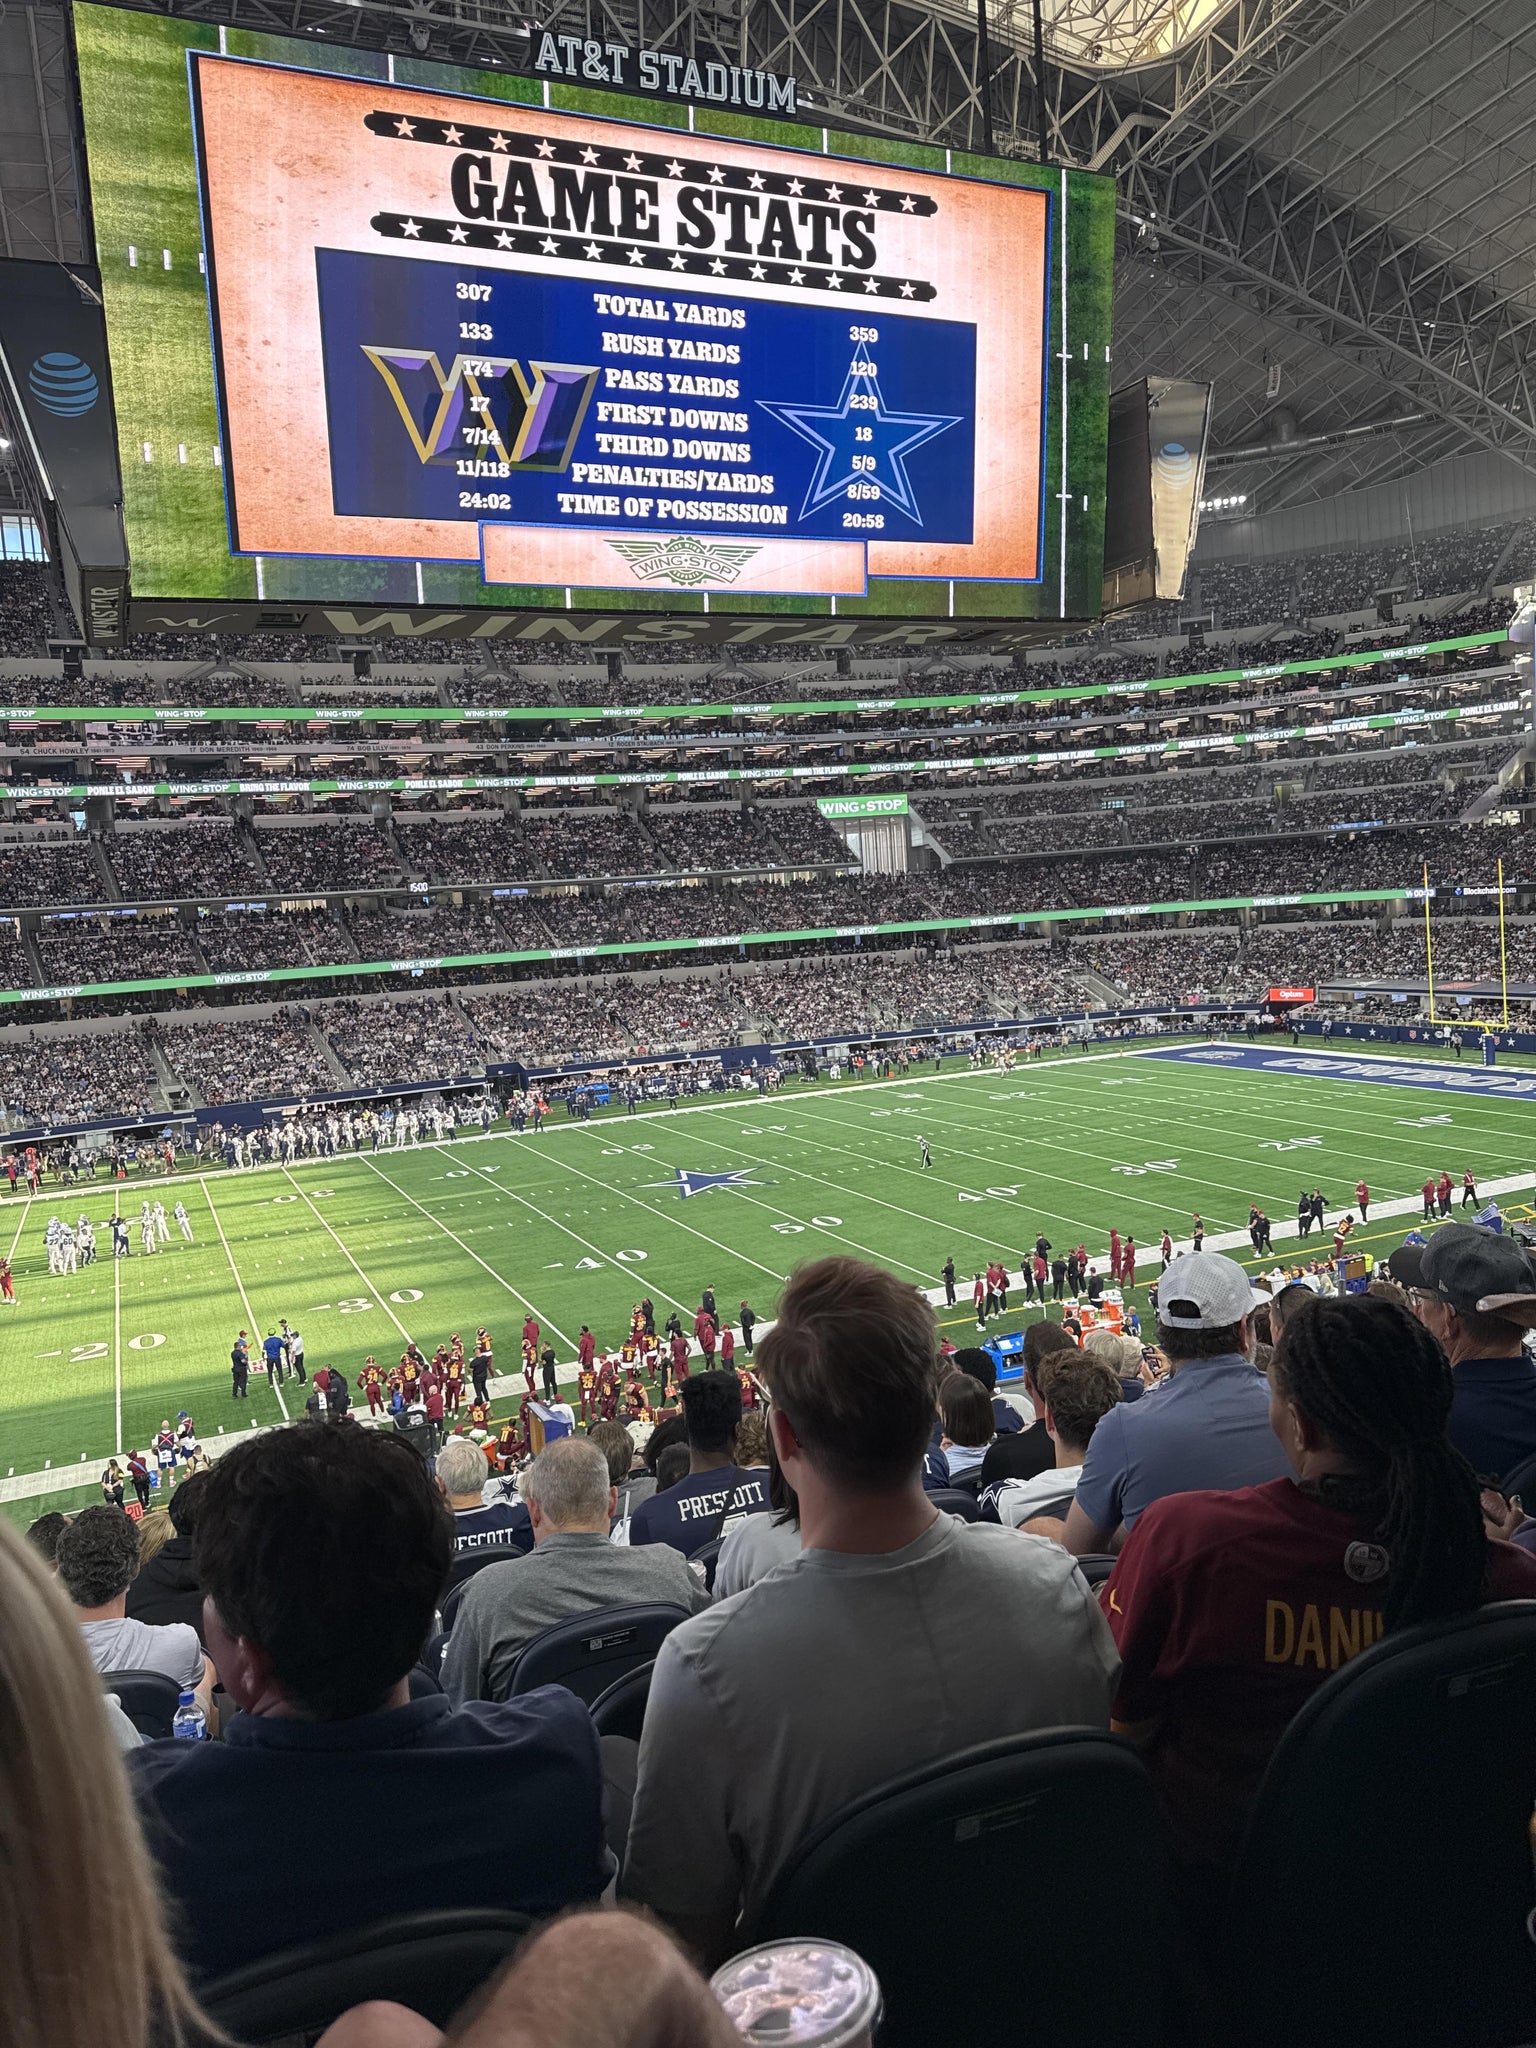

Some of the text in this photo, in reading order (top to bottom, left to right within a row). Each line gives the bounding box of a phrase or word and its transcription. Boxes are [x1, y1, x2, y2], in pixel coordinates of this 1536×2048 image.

[535, 32, 797, 114] AT&T STADIUM
[451, 153, 877, 270] GAME STATS
[456, 283, 493, 301] 307
[594, 294, 746, 329] TOTAL YARDS
[459, 323, 493, 340] 133
[849, 326, 878, 343] 359
[602, 332, 740, 364] RUSH YARDS
[462, 360, 493, 377] 174
[851, 361, 877, 377] 120
[605, 367, 740, 399] PASS YARDS
[470, 396, 489, 412] 17
[850, 394, 878, 410] 239
[597, 401, 748, 432] FIRST DOWNS
[463, 427, 500, 446] 7/14
[855, 427, 873, 441] 18
[595, 433, 751, 463] THIRD DOWNS
[456, 460, 511, 478] 11/118
[851, 455, 876, 471] 5/9
[572, 462, 774, 495] PENALTIES/YARDS
[459, 492, 511, 510] 24:02
[847, 484, 880, 500] 8/59
[558, 493, 788, 524] TIME OF POSSESSION
[842, 513, 884, 529] 20:58
[90, 586, 119, 638] WINSTAR
[322, 610, 960, 646] WINSTAR
[1463, 886, 1516, 895] Blockchaincom
[1279, 990, 1304, 999] Optum
[770, 1216, 843, 1234] 50
[574, 1249, 648, 1270] 40
[339, 1288, 424, 1314] 30
[70, 1333, 167, 1362] 20
[454, 1527, 513, 1551] ESCOTT
[1264, 1600, 1384, 1669] DANI
